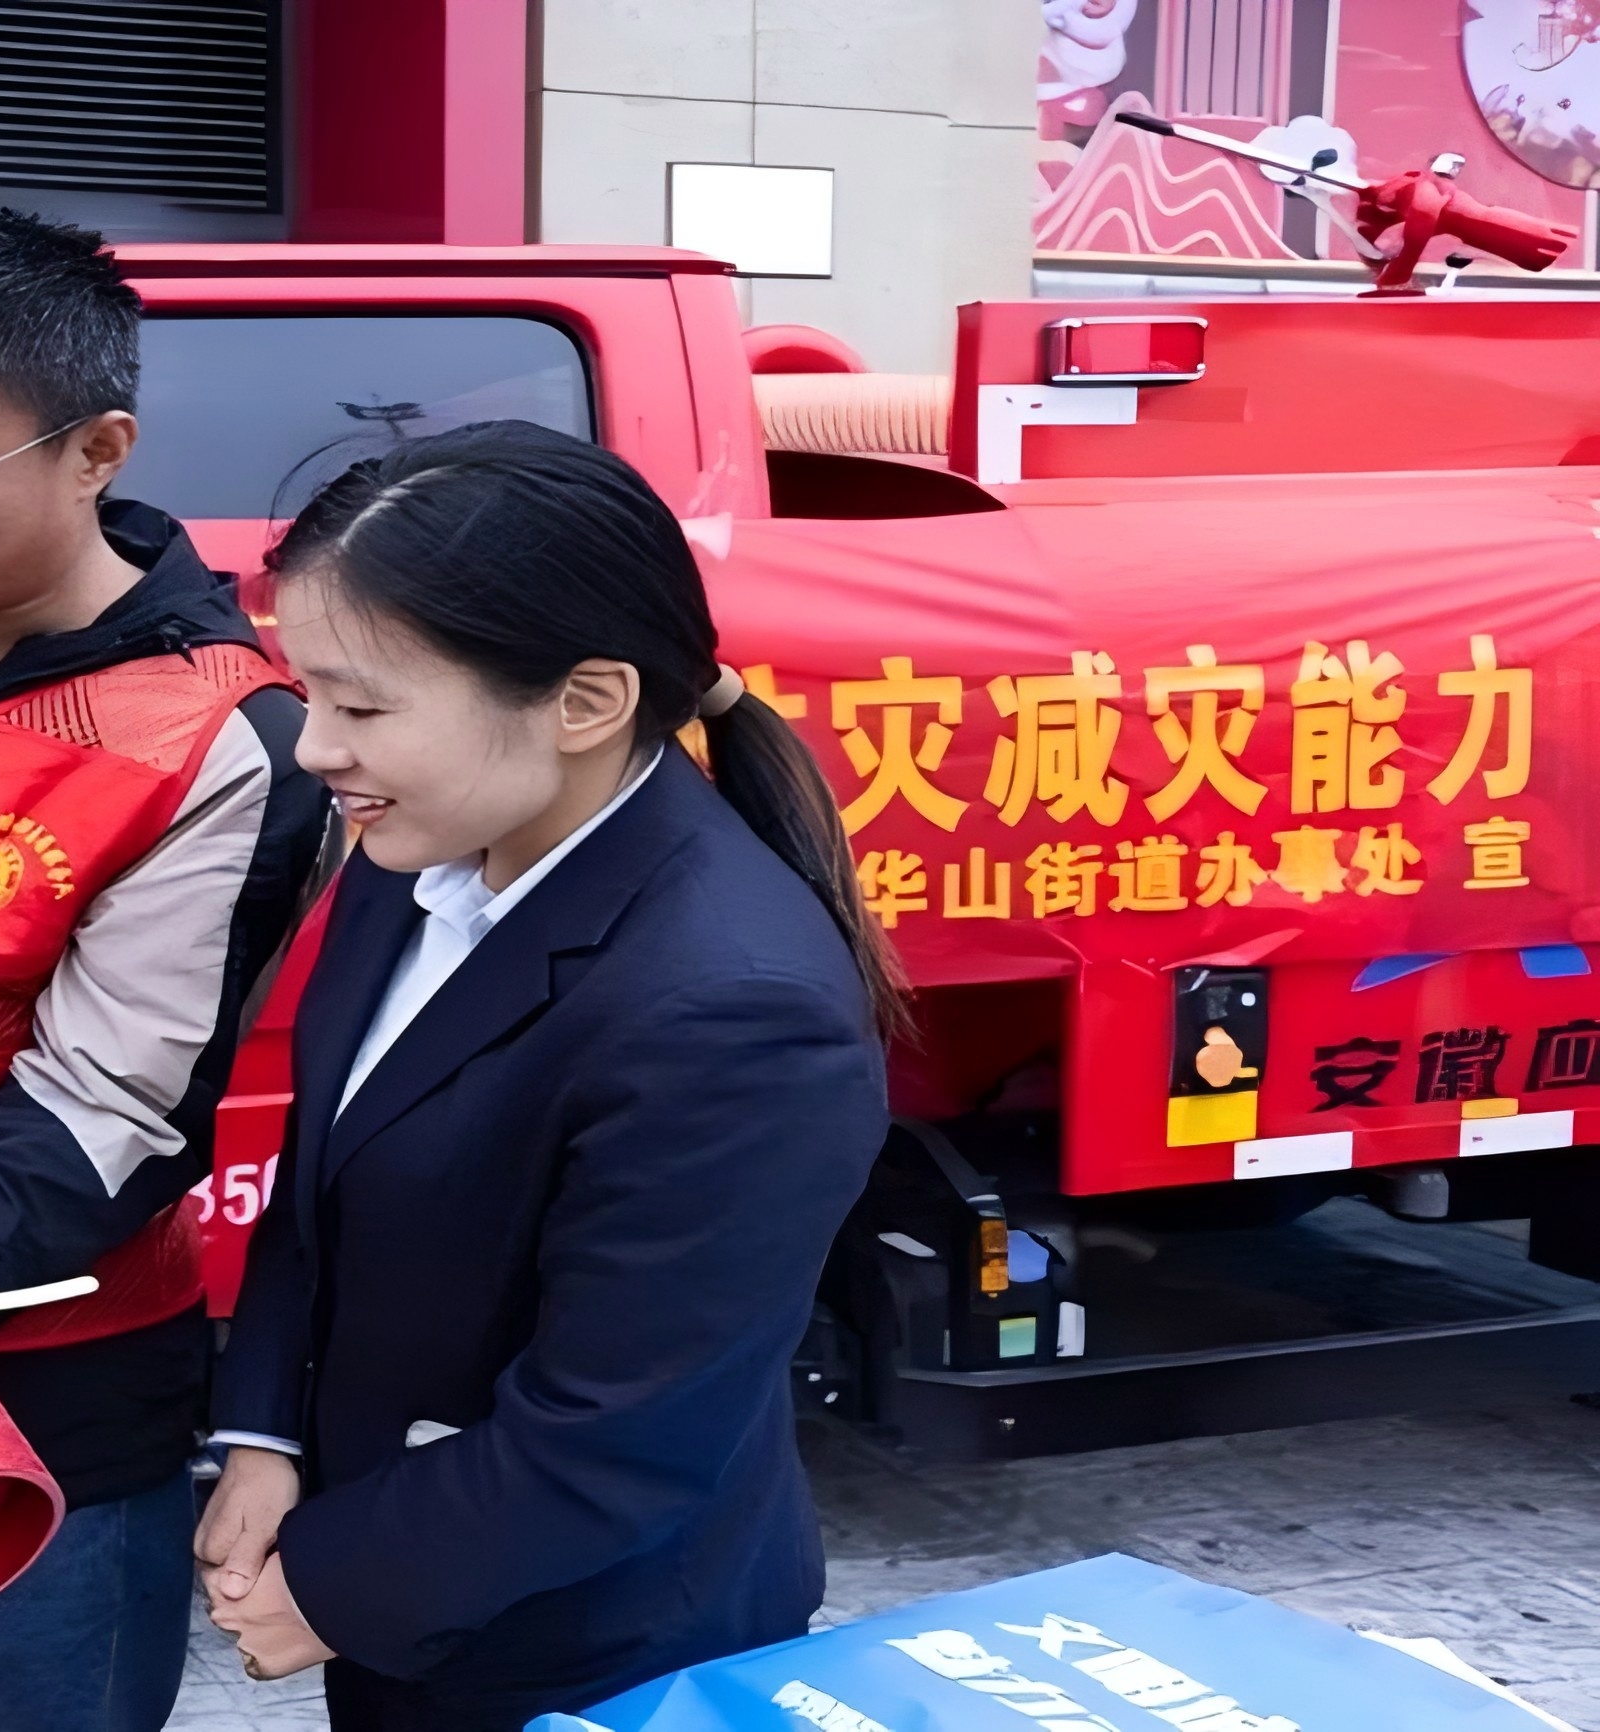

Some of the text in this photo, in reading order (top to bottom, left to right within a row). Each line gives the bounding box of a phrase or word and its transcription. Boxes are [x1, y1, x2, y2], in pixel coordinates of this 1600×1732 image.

[855, 815, 1532, 929] 华山街道办事处 宣
